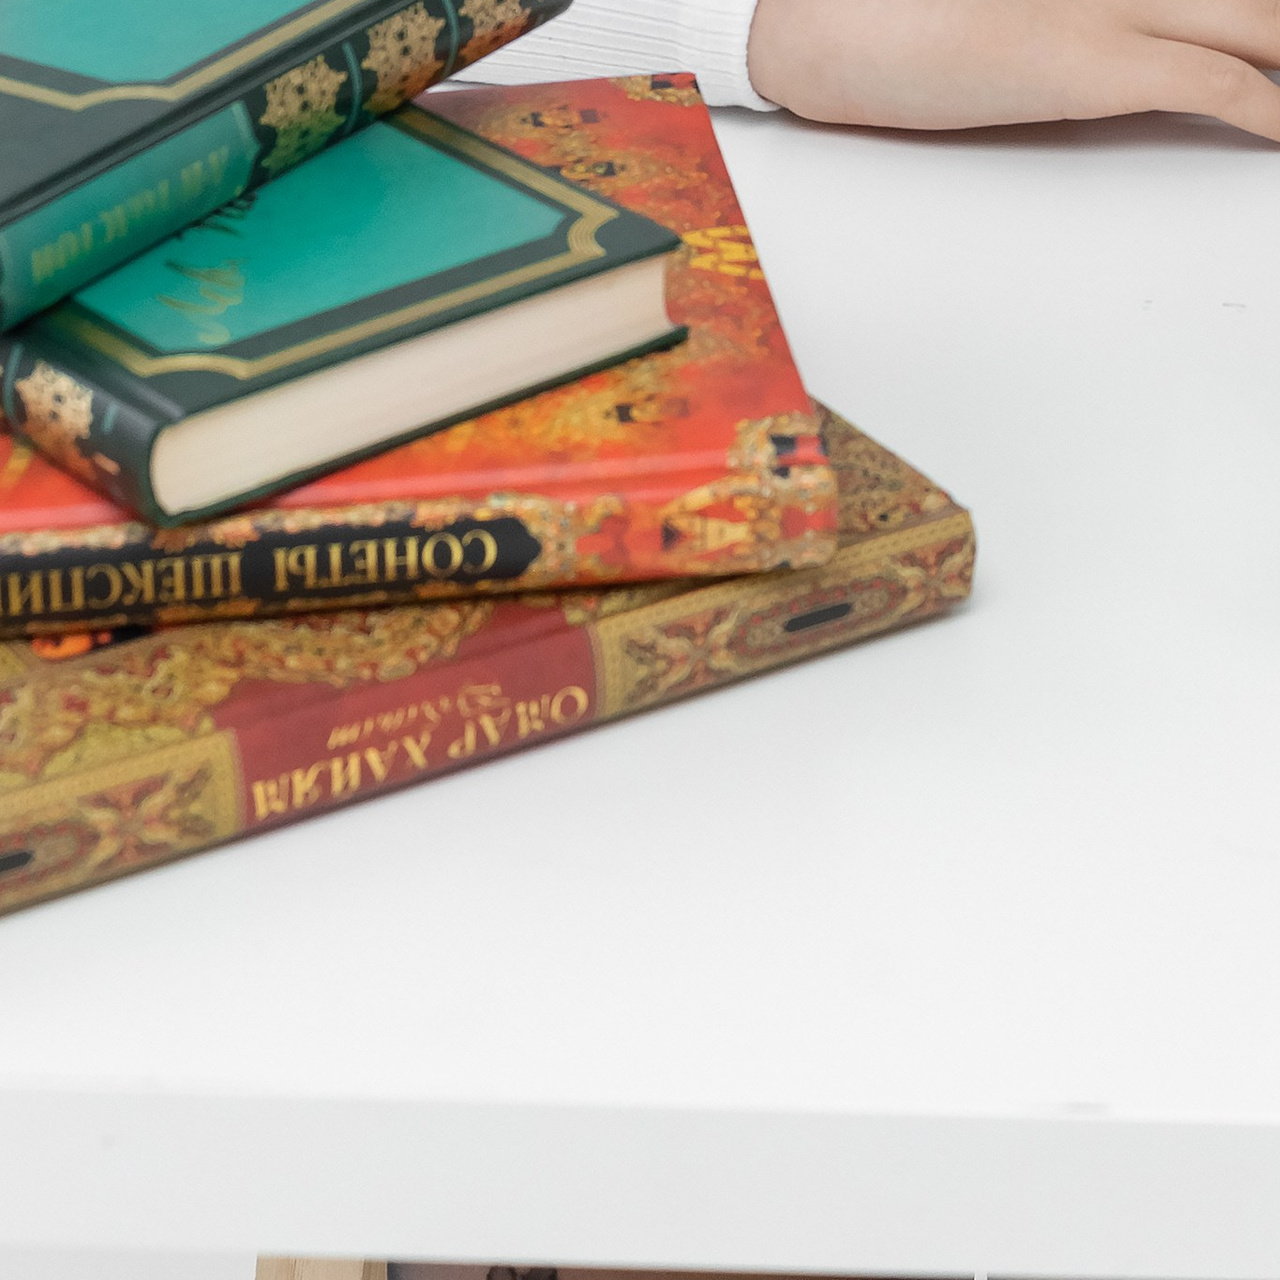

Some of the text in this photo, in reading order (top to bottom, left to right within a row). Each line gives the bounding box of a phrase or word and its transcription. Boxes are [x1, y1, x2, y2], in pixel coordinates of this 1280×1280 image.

[0, 528, 499, 617] СОНЕТЫ ШЕКСПИ
[449, 685, 589, 760] ОМАР
